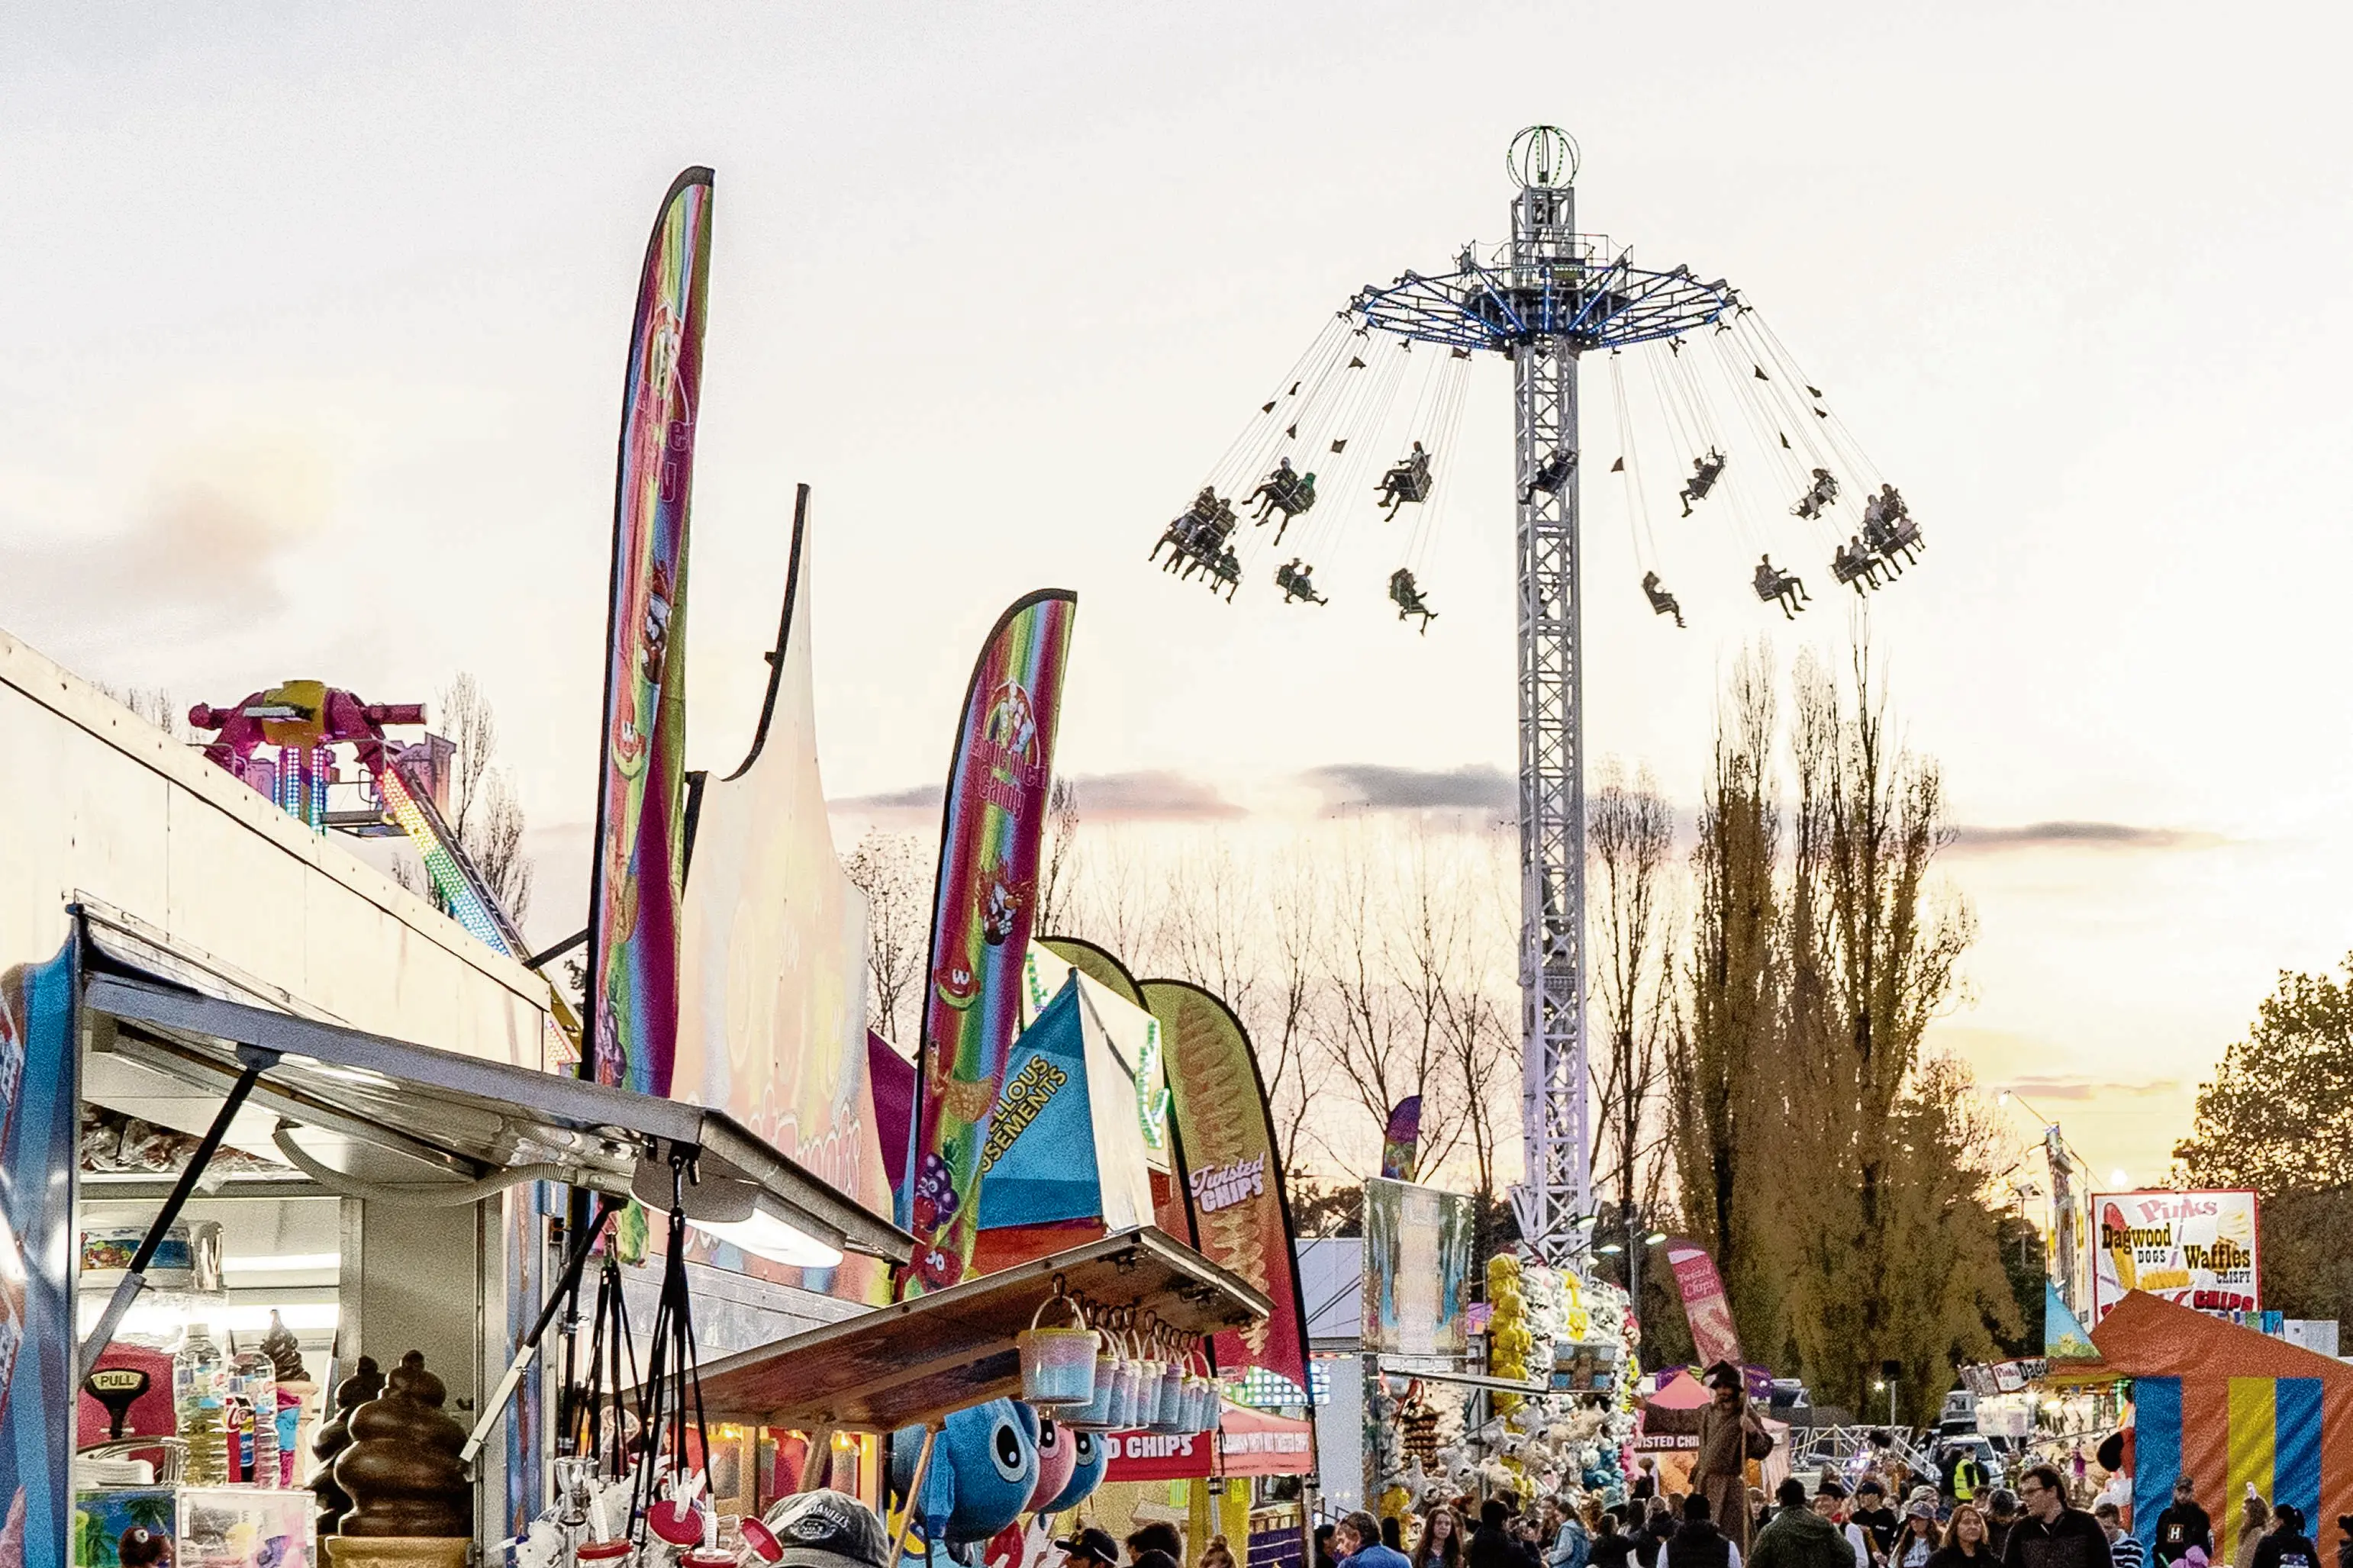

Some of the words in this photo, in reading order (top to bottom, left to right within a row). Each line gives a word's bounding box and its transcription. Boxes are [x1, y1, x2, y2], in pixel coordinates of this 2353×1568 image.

[1189, 1151, 1265, 1198] Twisted
[1201, 1173, 1264, 1212] CHIPS
[2138, 1197, 2218, 1223] Pinks
[2101, 1222, 2172, 1254] Dagwood
[2138, 1250, 2167, 1264] DOGS
[2184, 1244, 2251, 1270] Waffles
[2216, 1271, 2251, 1283] CRISPY
[2193, 1289, 2254, 1312] CHIPS
[100, 1375, 134, 1386] PULL
[1126, 1434, 1194, 1458] CHIPS
[2171, 1527, 2181, 1541] H
